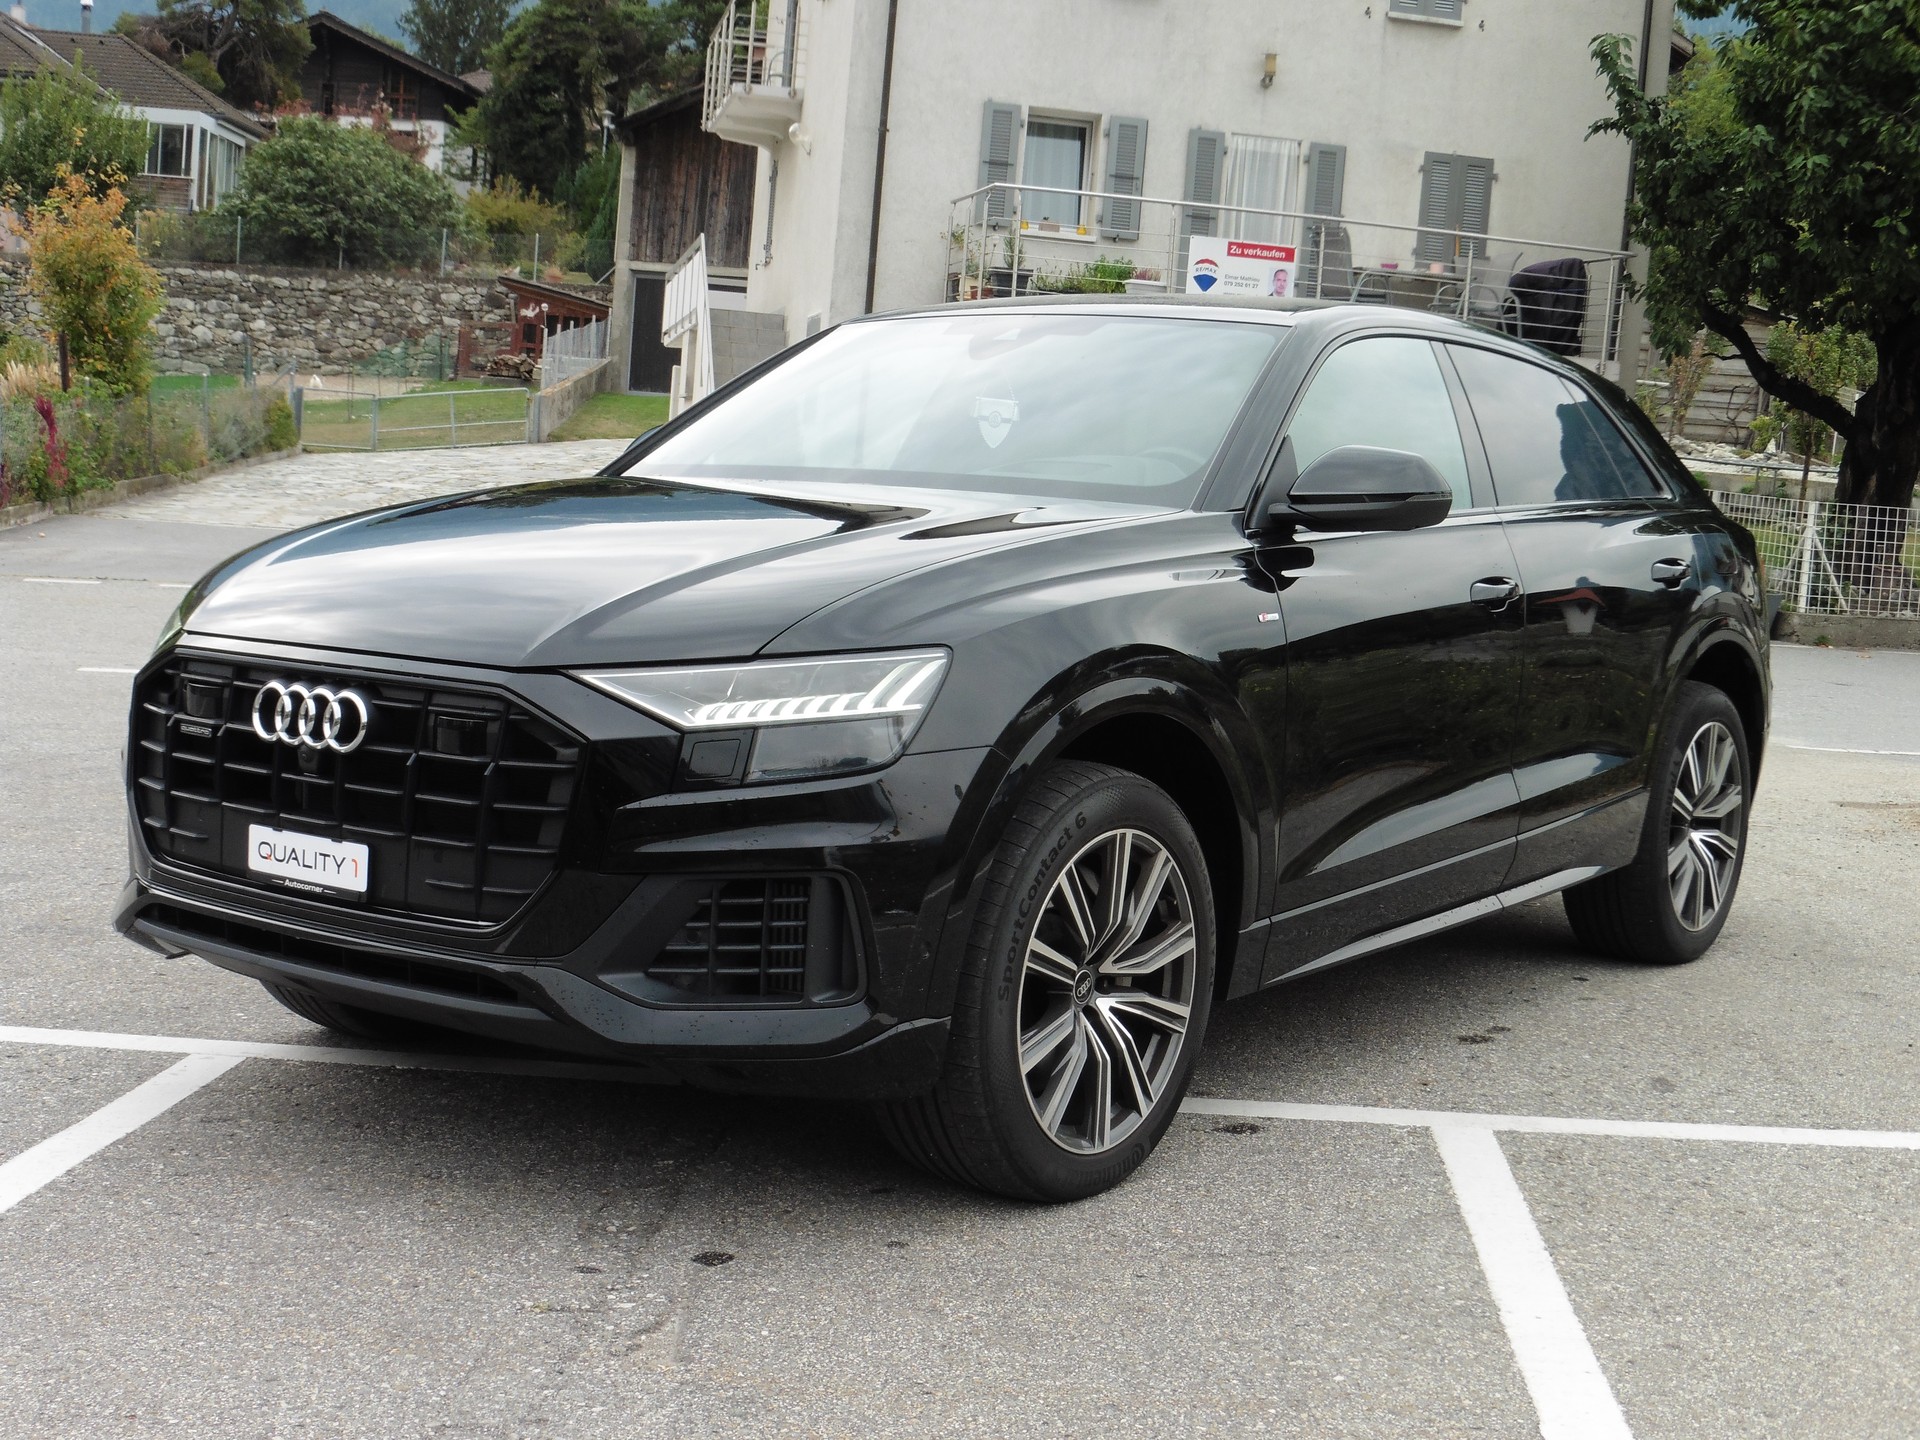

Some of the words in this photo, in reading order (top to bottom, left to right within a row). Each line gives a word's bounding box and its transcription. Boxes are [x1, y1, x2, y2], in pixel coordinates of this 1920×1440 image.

[1230, 245, 1241, 254] Zu
[1243, 247, 1285, 259] verkaufen
[1195, 266, 1217, 274] RE/MAX
[258, 841, 346, 875] QUALITY
[351, 858, 358, 878] 1
[284, 879, 324, 893] Autocorner
[998, 826, 1074, 1001] SportContact
[1075, 811, 1088, 830] 6
